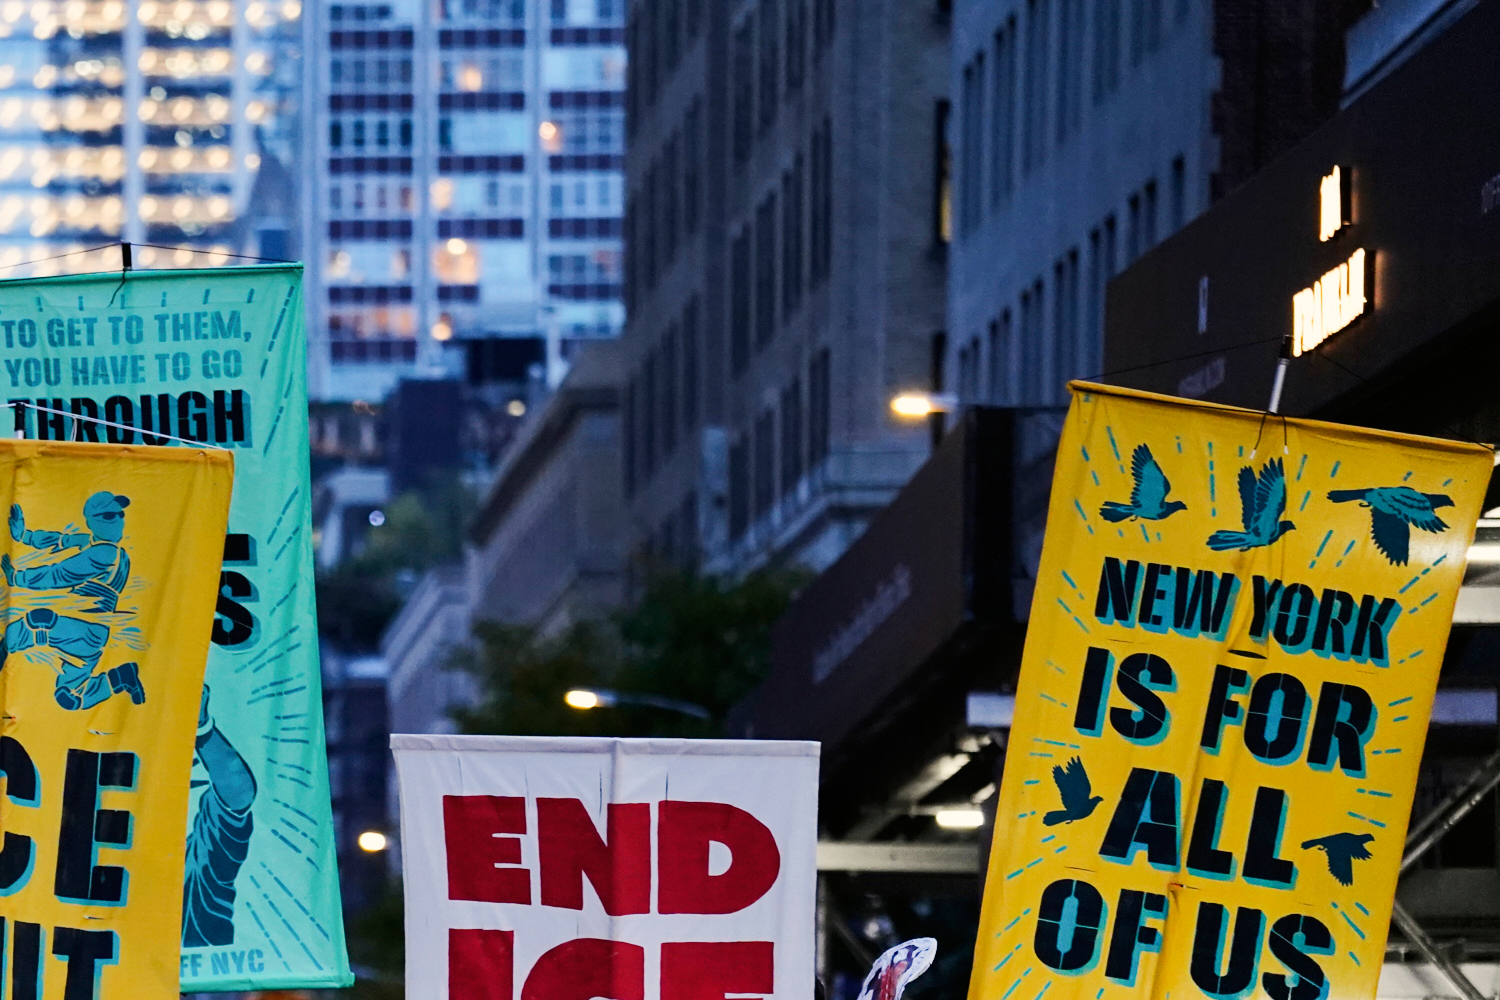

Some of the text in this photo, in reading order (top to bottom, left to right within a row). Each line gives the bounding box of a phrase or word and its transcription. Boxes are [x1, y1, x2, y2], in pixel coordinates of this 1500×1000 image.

[0, 310, 252, 348] TO GET TO THEM,
[4, 349, 243, 387] YOU HAVE TO GO
[7, 389, 252, 448] THROUGH
[1094, 556, 1402, 668] NEW YORK
[1074, 646, 1380, 779] IS FOR
[443, 795, 781, 916] END
[1098, 767, 1298, 891] ALL
[211, 949, 265, 975] NYC
[1033, 877, 1169, 988] OF
